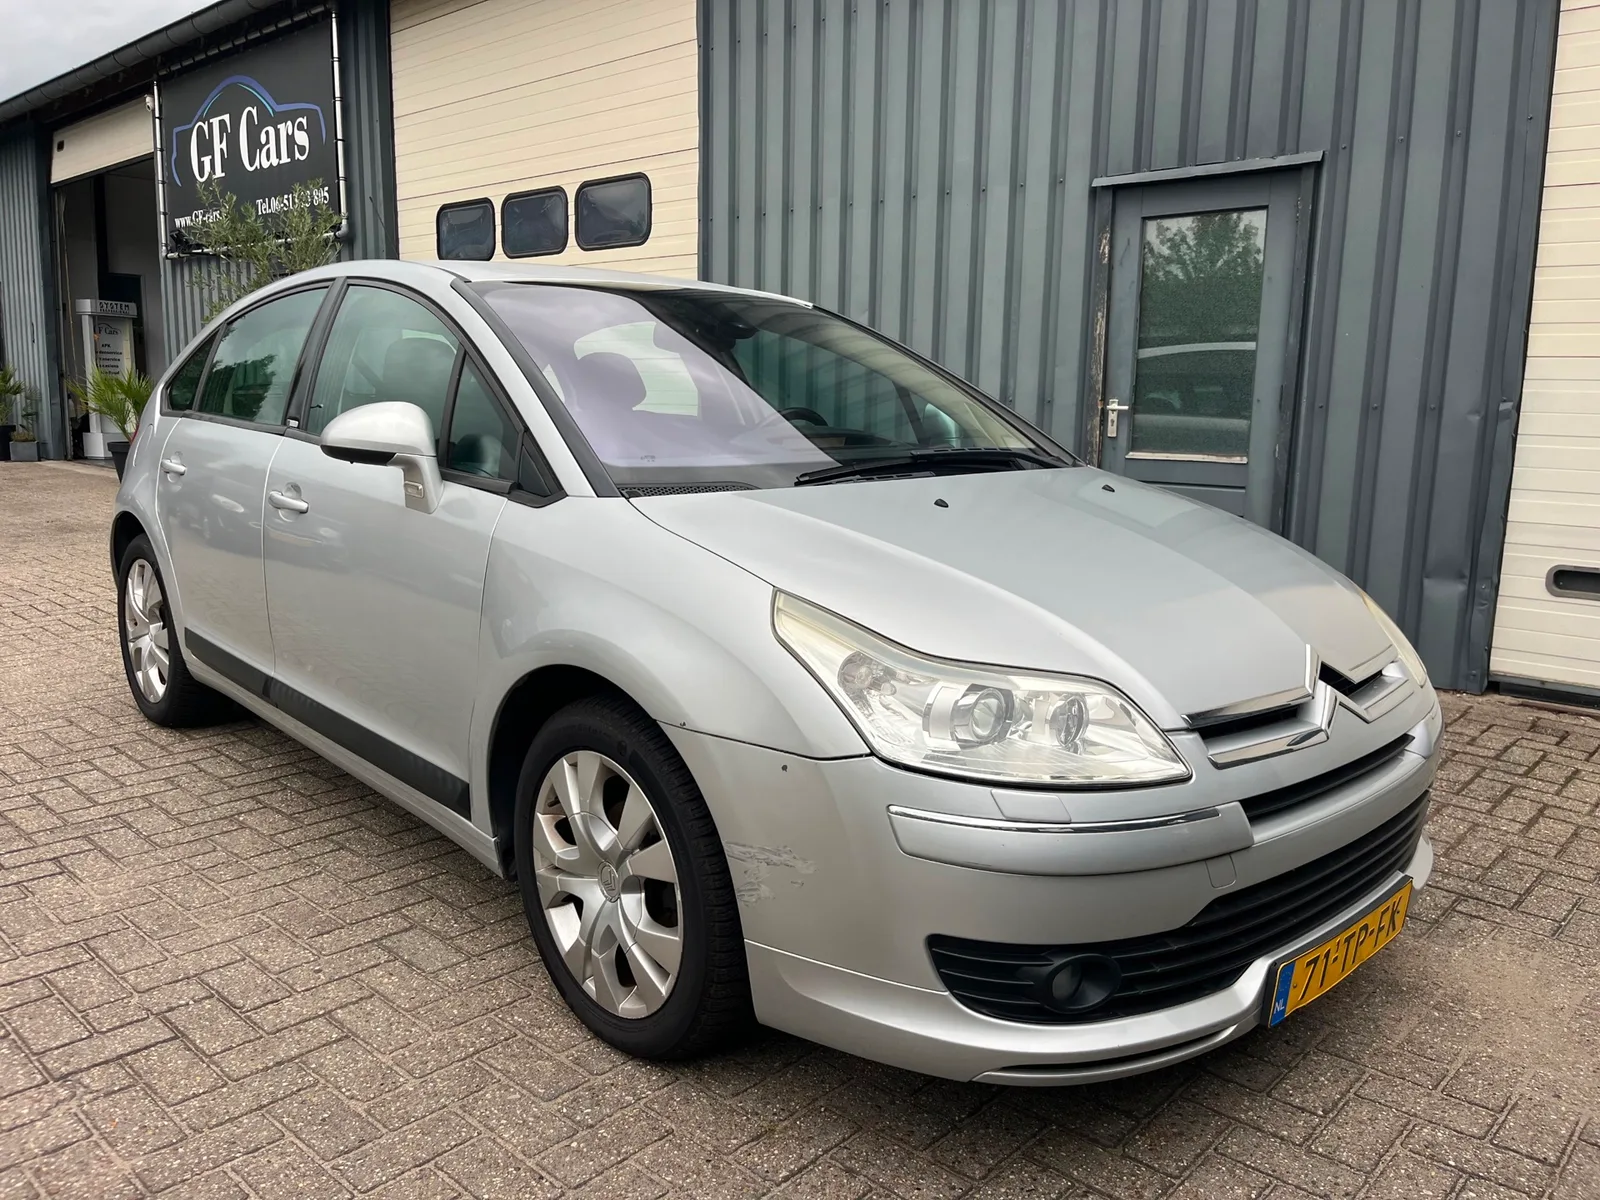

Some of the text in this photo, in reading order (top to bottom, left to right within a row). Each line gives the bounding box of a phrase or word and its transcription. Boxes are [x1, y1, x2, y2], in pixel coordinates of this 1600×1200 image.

[190, 105, 310, 183] GF Cars
[99, 302, 130, 310] SYSTEM
[105, 327, 118, 335] Cars
[1298, 896, 1403, 1001] 71-TP-FK
[1273, 1000, 1285, 1014] NL
